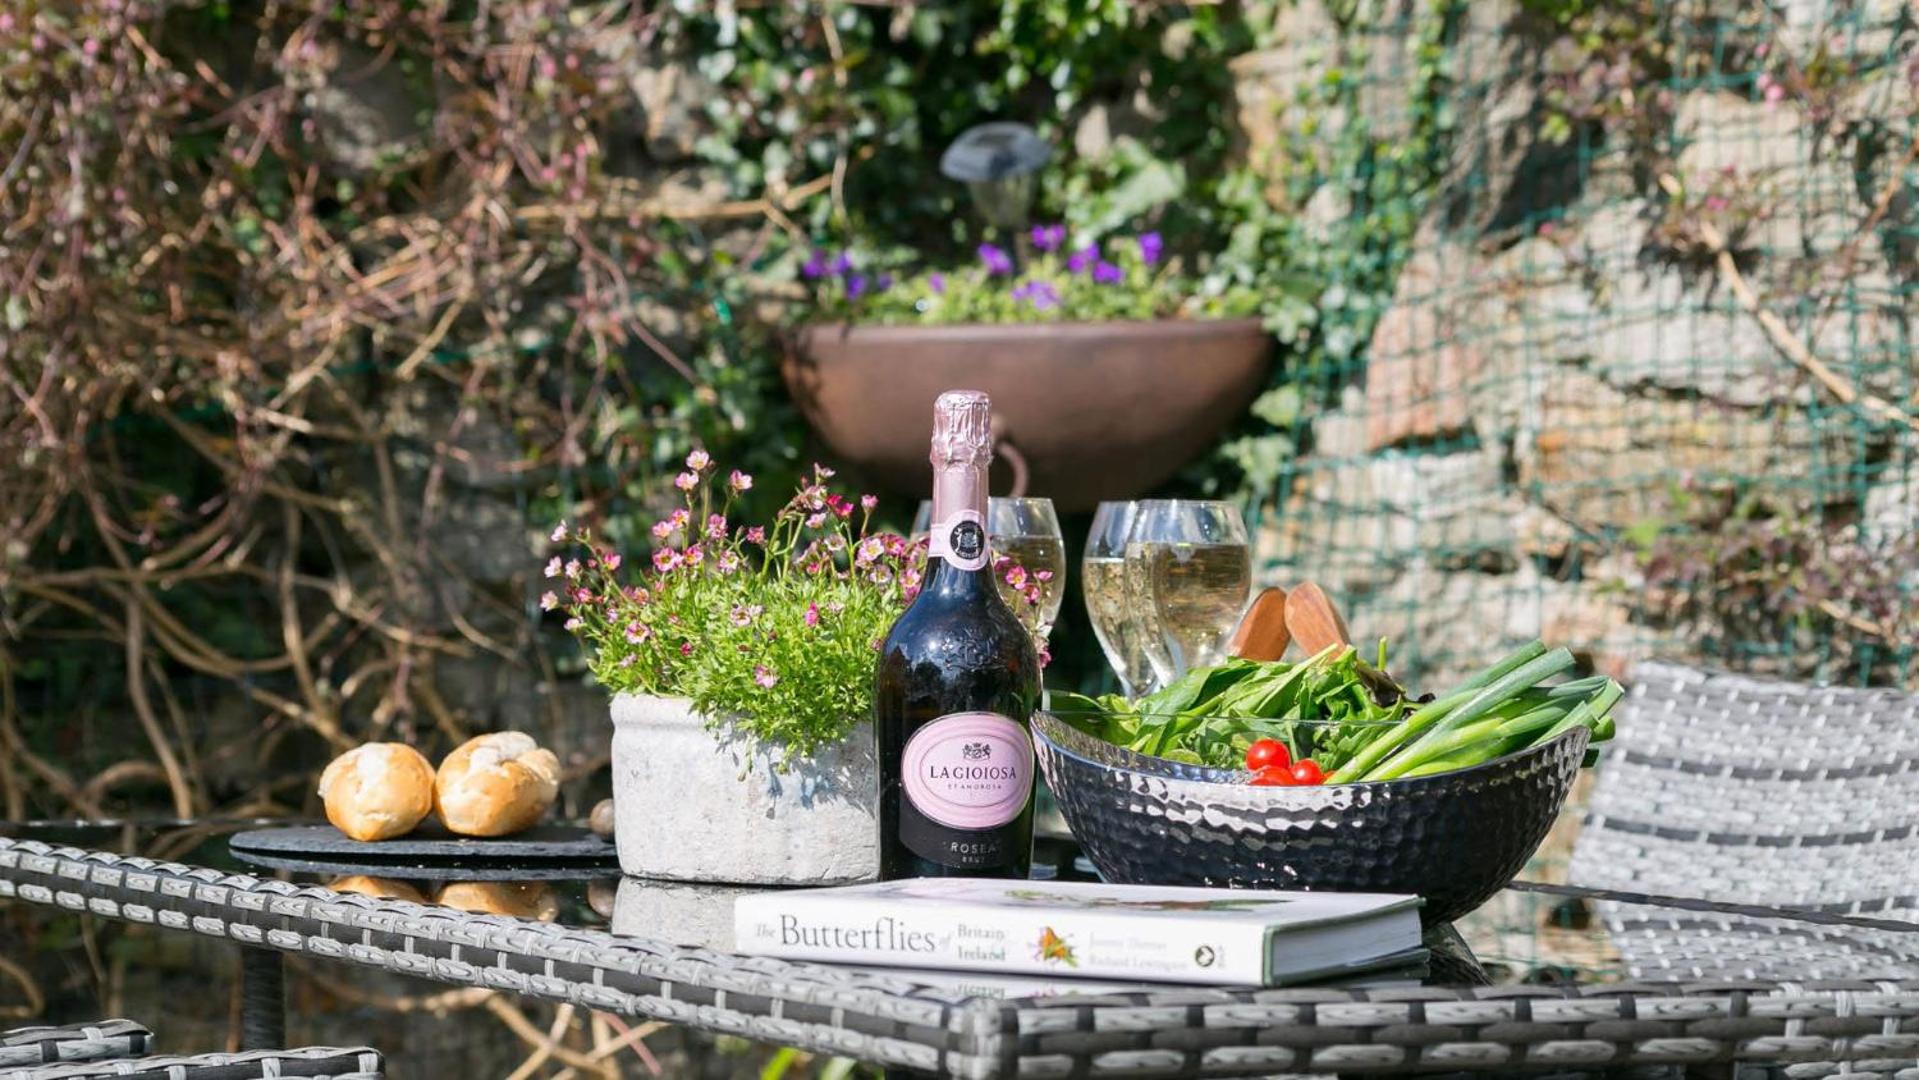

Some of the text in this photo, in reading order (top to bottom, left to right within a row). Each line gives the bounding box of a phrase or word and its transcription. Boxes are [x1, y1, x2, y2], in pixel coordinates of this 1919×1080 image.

[930, 765, 1017, 780] LA GIOIOSA
[756, 923, 776, 938] The
[780, 914, 936, 952] Butterflies
[957, 923, 1005, 941] Britain
[957, 945, 1006, 962] Ireland
